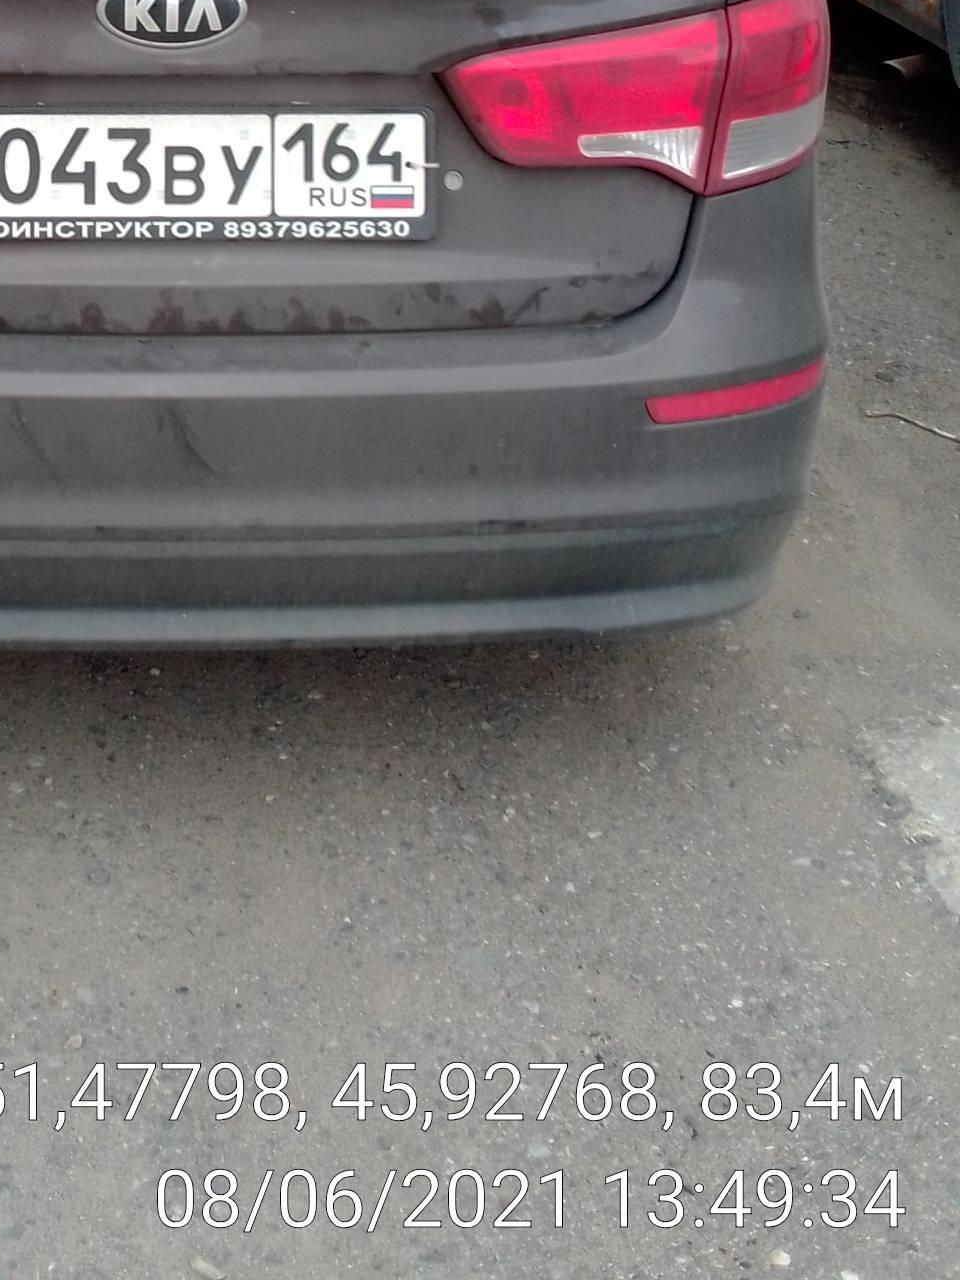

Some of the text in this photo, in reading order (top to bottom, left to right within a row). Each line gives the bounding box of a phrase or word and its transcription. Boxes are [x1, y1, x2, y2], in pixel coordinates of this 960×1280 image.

[282, 122, 403, 183] 164
[308, 186, 368, 208] RUS
[223, 220, 410, 239] 89379625630
